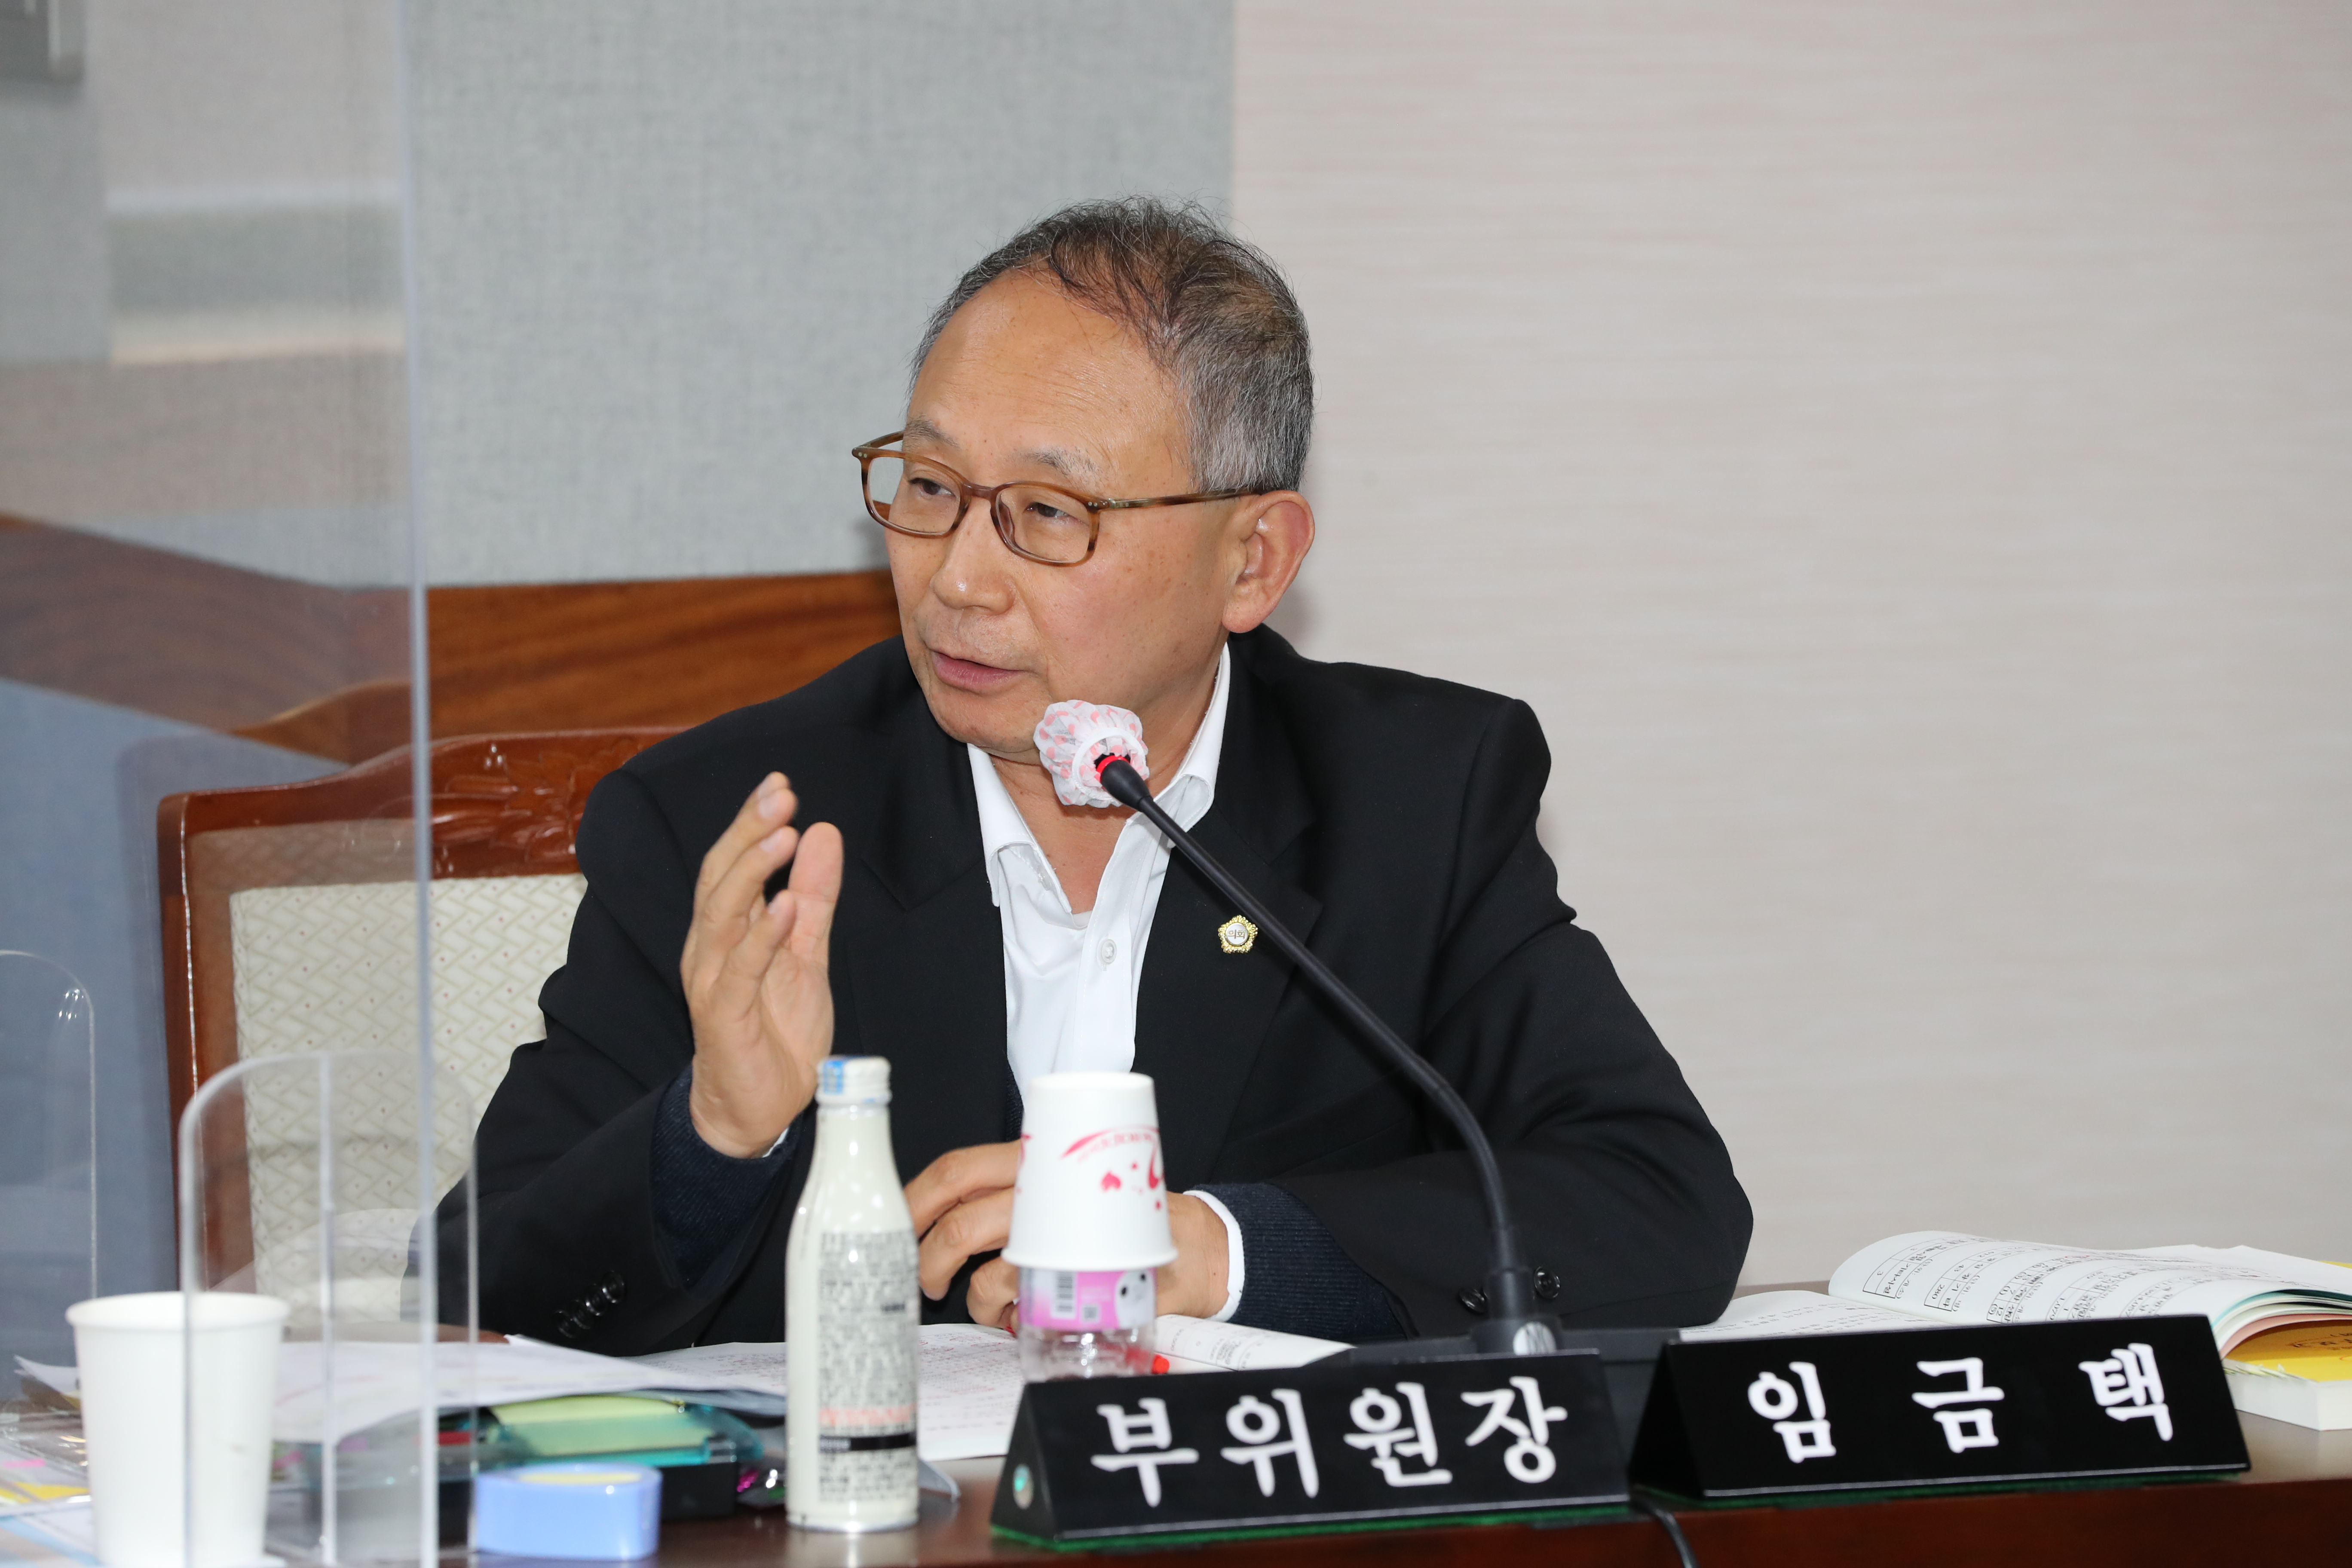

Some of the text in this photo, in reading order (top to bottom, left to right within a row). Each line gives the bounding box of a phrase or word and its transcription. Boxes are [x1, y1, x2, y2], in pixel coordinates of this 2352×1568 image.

[1227, 929, 1246, 939] 의회
[1883, 1263, 1911, 1294] 기타시설
[1932, 1284, 1945, 1299] 280
[1996, 1307, 2003, 1316] 12
[1091, 1377, 1568, 1507] 부위원장
